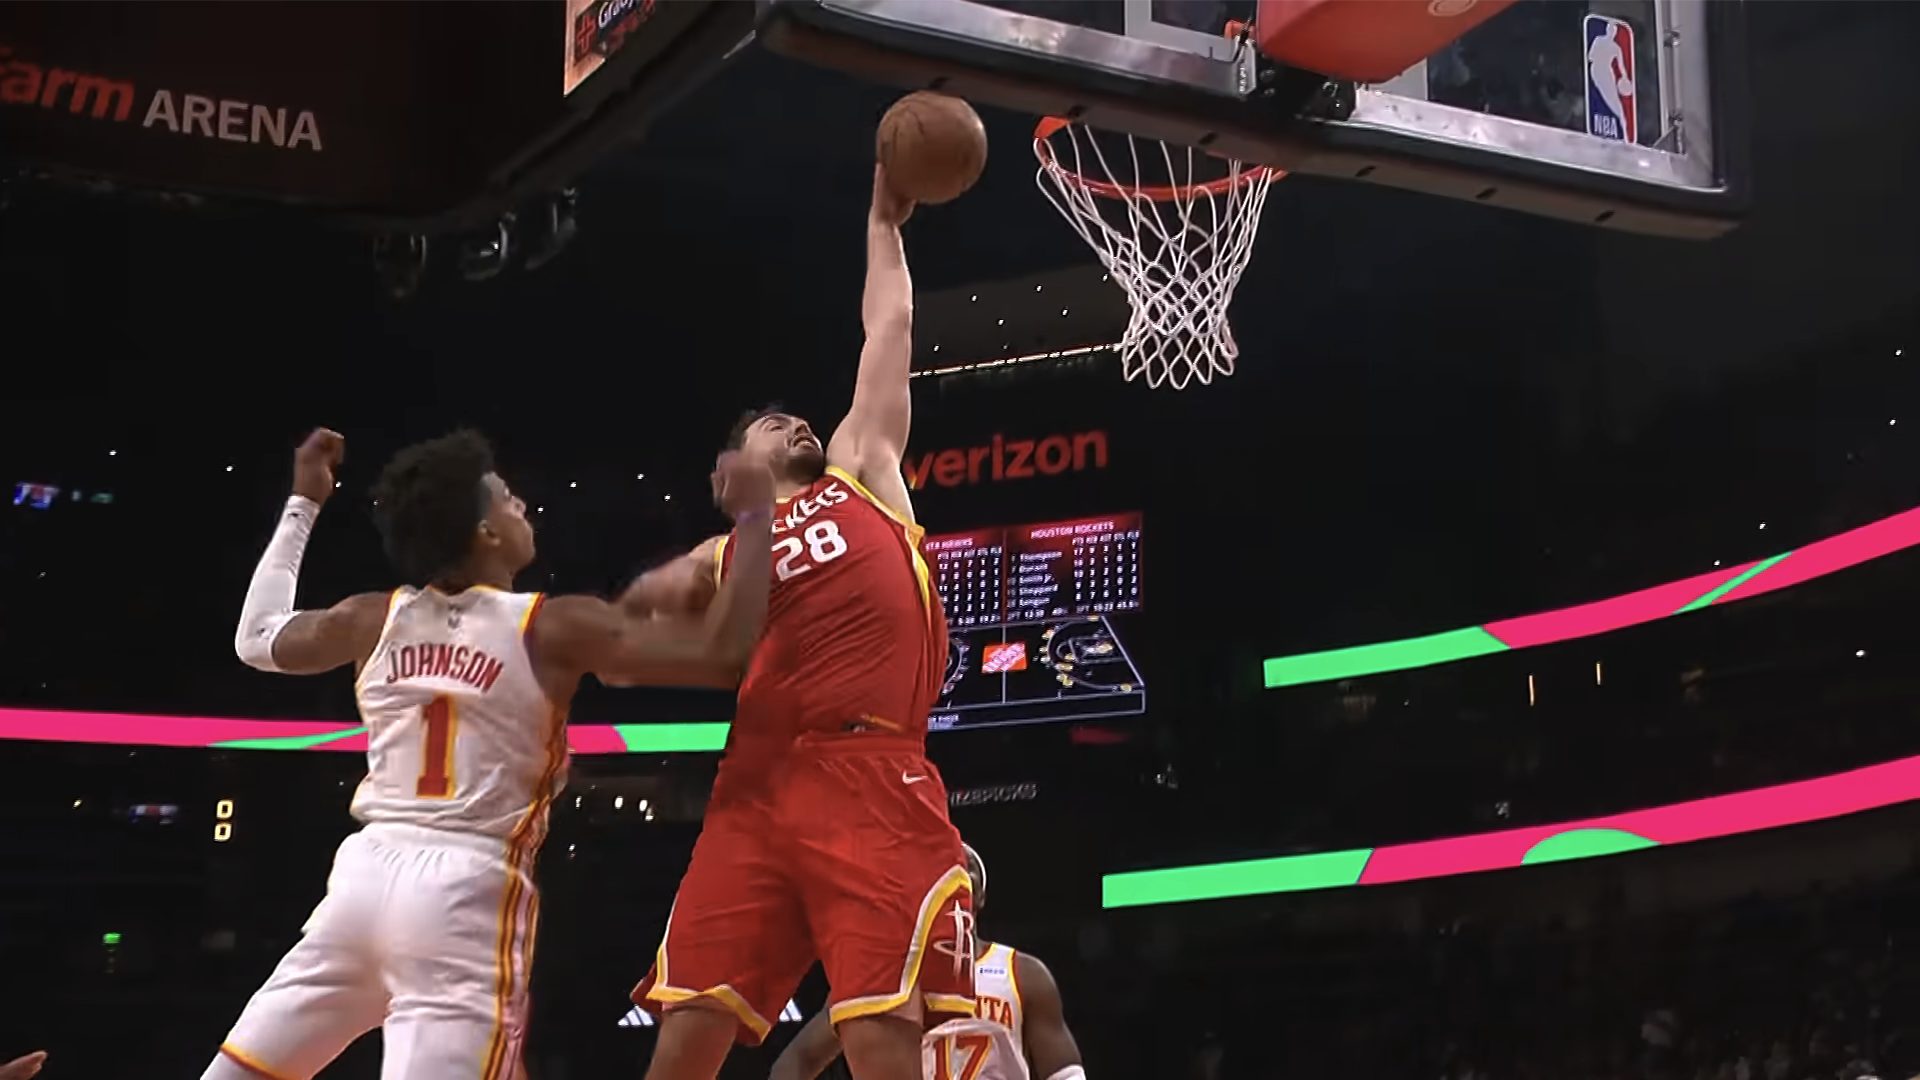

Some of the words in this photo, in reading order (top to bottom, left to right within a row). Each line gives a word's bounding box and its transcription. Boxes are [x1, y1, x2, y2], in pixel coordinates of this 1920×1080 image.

[0, 46, 135, 121] arm
[142, 89, 322, 150] ARENA
[1593, 113, 1618, 138] NBA
[904, 430, 1109, 490] verizon
[770, 520, 847, 581] 28
[1031, 528, 1073, 540] HOUSTON
[1075, 521, 1114, 534] ROCKETS
[386, 642, 504, 693] JOHNSON
[415, 693, 457, 798] 1
[932, 1033, 993, 1080] 17
